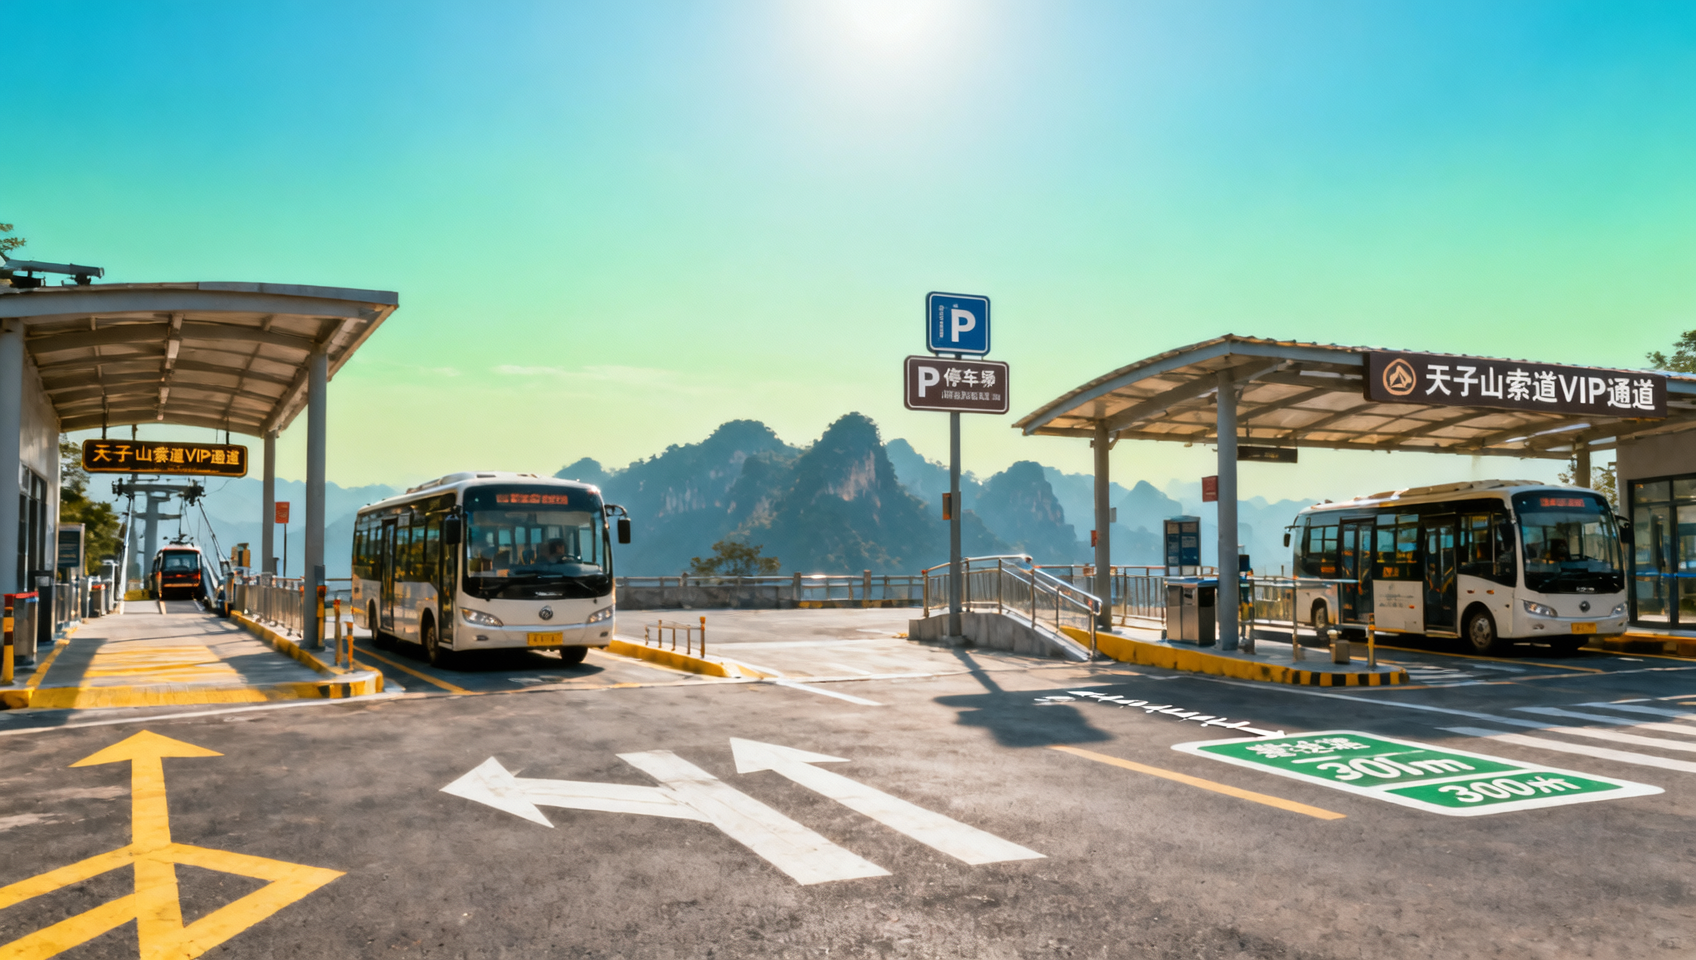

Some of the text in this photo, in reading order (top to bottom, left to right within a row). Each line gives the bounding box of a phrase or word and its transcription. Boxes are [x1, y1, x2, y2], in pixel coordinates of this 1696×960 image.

[951, 308, 976, 343] P
[918, 366, 940, 398] P
[1425, 364, 1656, 411] 天子山索道VIP通道
